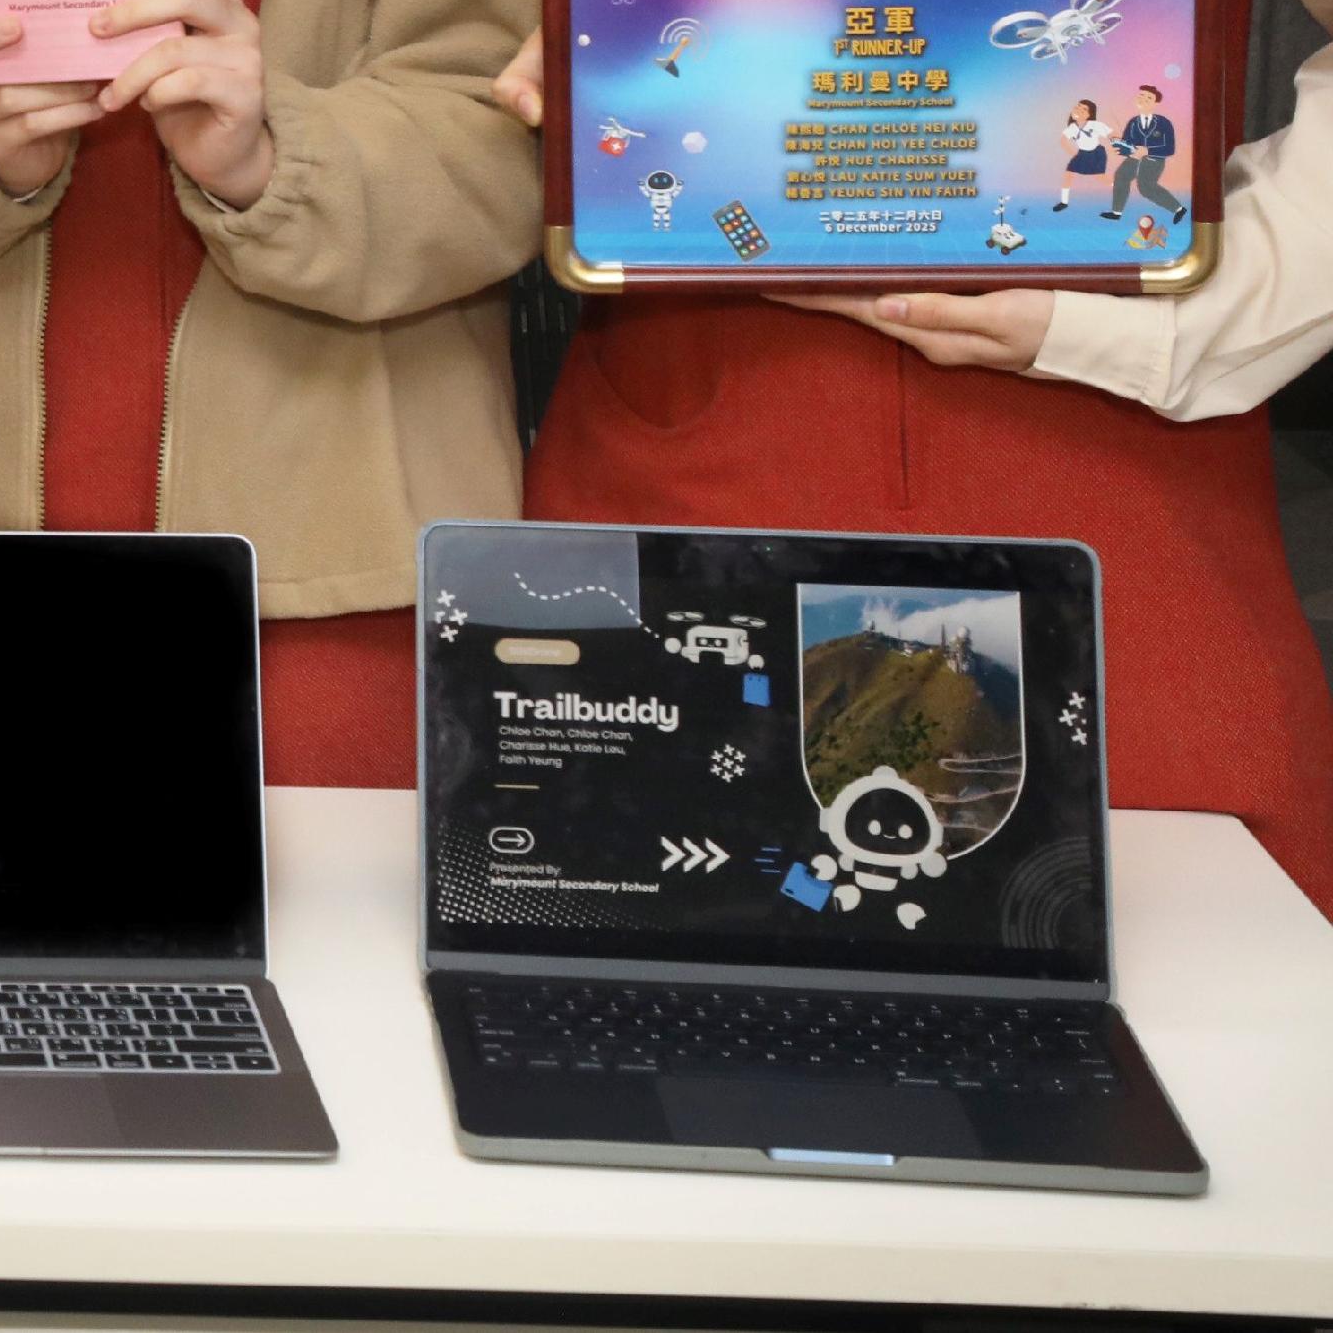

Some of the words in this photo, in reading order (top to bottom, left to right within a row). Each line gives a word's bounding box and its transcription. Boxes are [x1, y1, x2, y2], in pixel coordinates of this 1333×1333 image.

[9, 2, 61, 13] Marymount
[845, 6, 915, 35] 亞軍
[852, 38, 926, 56] RUNNER-UP
[812, 69, 949, 93] 瑪利曼中學
[808, 98, 864, 108] Marymount
[866, 98, 917, 108] Secondary
[919, 97, 954, 106] School
[829, 124, 868, 134] CHAN
[872, 123, 918, 133] CHLOE
[922, 122, 946, 132] HEI
[951, 122, 976, 132] KIU
[829, 139, 866, 149] CHAN
[871, 139, 896, 149] HOI
[901, 138, 926, 148] YEE
[930, 137, 977, 148] CHLOE
[845, 154, 874, 165] HUE
[878, 154, 946, 165] CHARISSE
[830, 171, 856, 182] LAU
[862, 170, 900, 181] KATIE
[905, 170, 935, 181] SUM
[939, 170, 976, 181] YUET
[828, 187, 875, 198] YEUNG
[880, 187, 904, 198] SIN
[908, 187, 932, 197] YIN
[935, 186, 977, 197] FAITH
[820, 209, 942, 222] 二零二五年十二月六日
[825, 222, 833, 233] 6
[836, 222, 902, 233] December
[906, 222, 937, 232] 2025
[493, 691, 679, 733] Trailbuddy
[499, 726, 531, 737] Chloe
[533, 726, 565, 739] Chan,
[567, 727, 599, 739] Chloe
[601, 729, 633, 742] Chan,
[499, 740, 547, 751] Charisse
[548, 741, 573, 753] Hue,
[574, 742, 602, 754] Katie
[499, 754, 527, 765] Faith
[529, 755, 563, 769] Yeung
[489, 862, 545, 875] Presented
[490, 876, 556, 890] Marymount
[558, 879, 620, 894] Secondary
[621, 881, 660, 893] School
